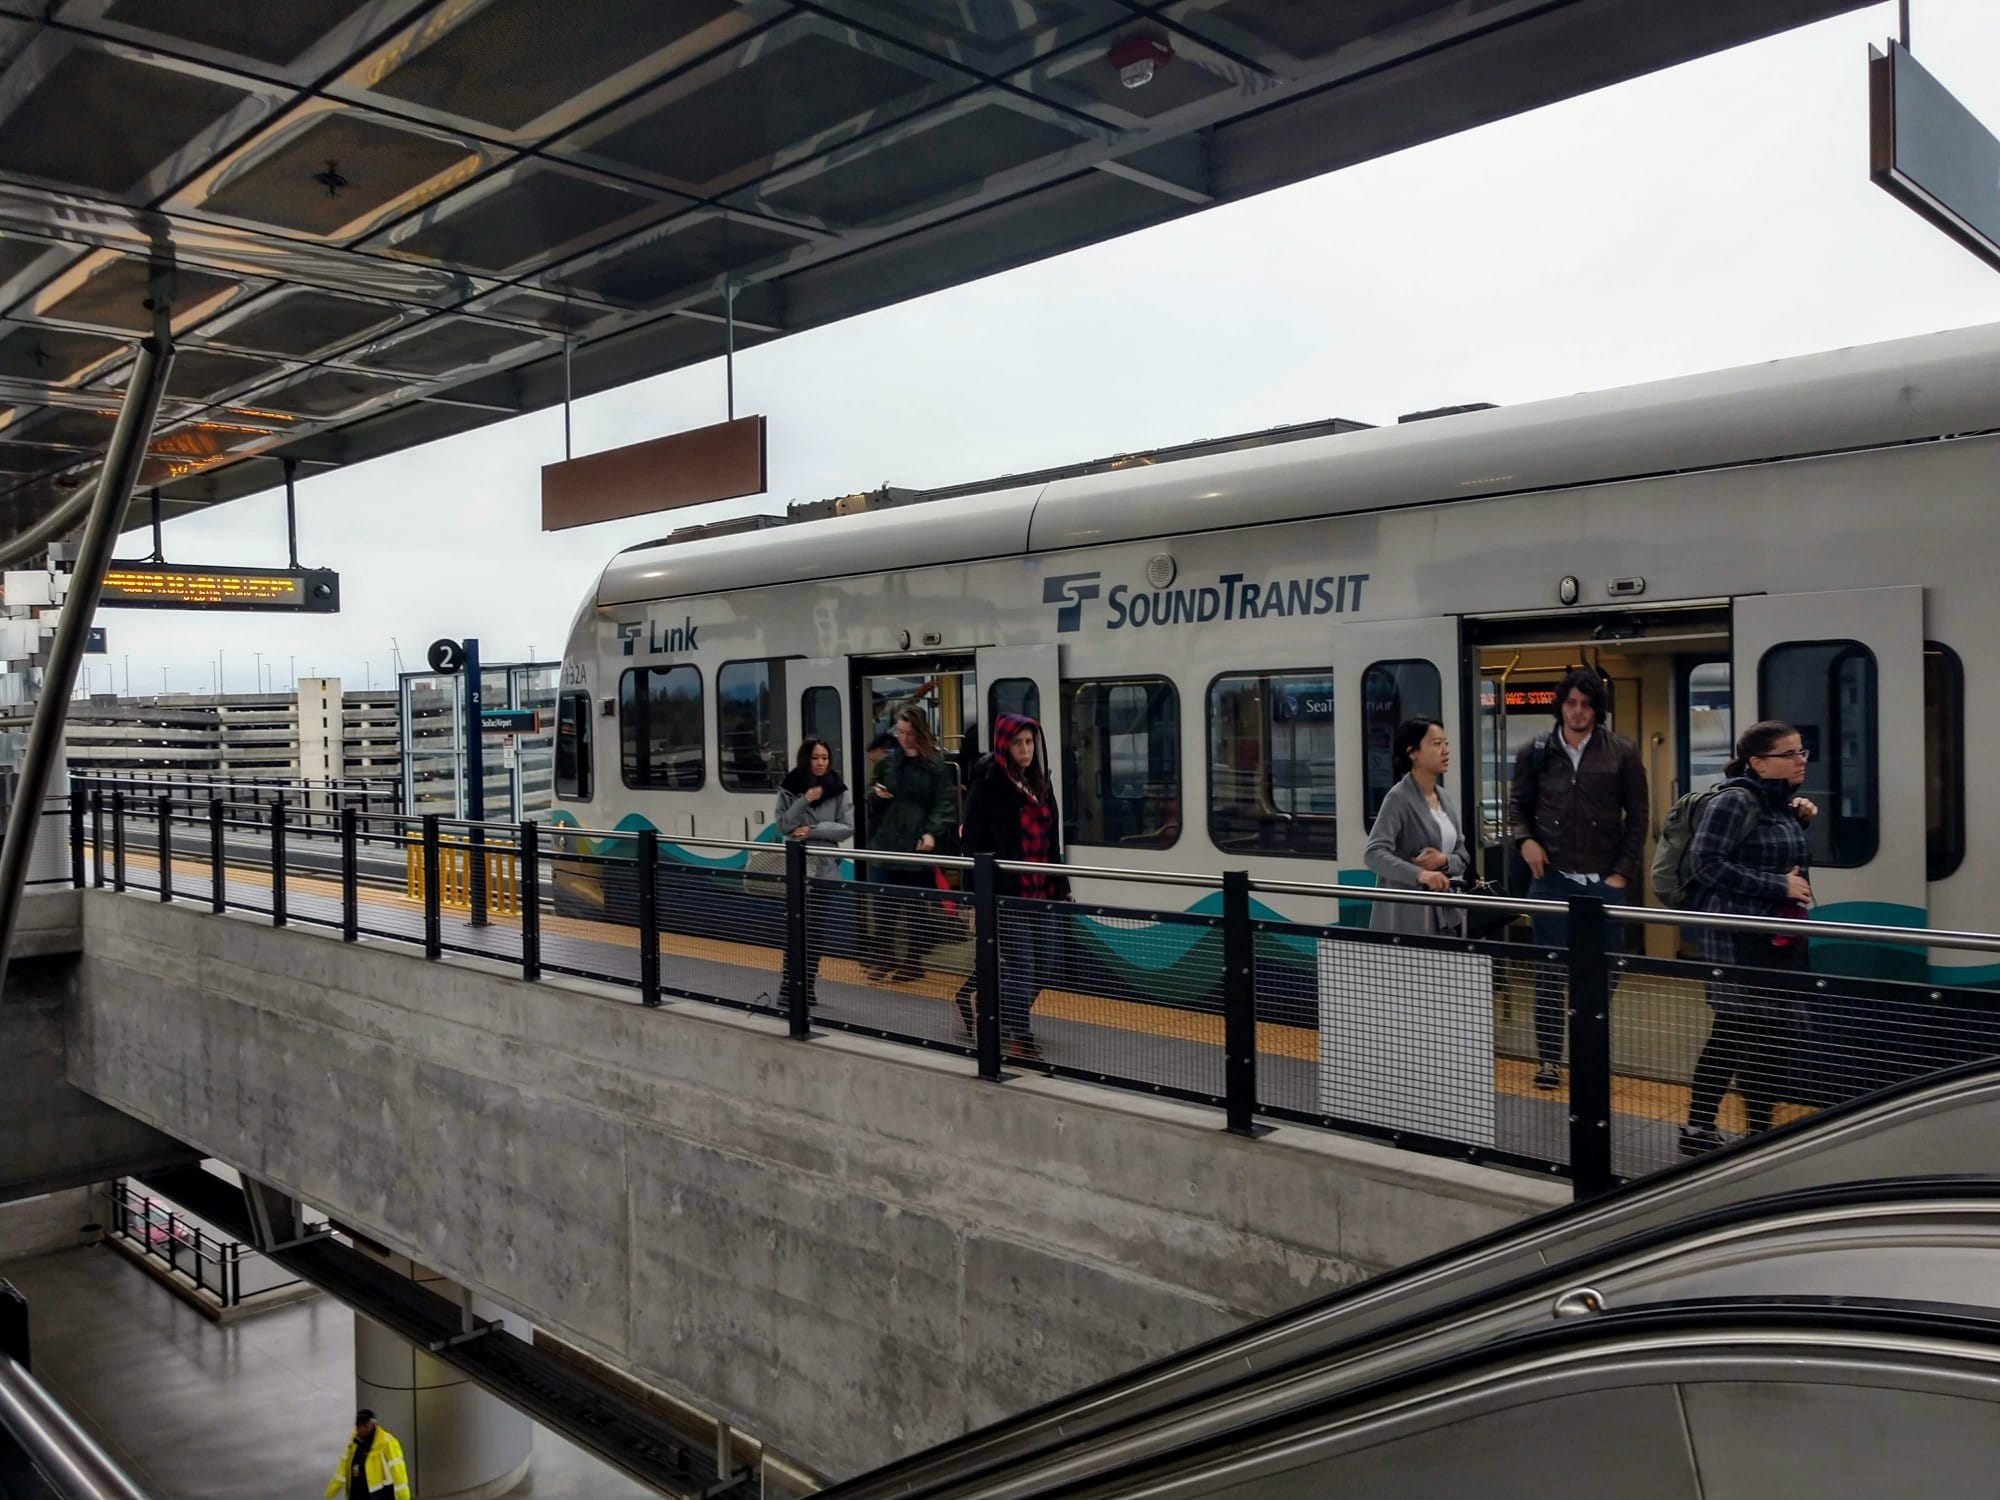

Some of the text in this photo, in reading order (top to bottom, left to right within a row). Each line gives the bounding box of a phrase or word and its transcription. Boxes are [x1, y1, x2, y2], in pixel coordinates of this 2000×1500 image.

[650, 615, 699, 654] Link
[439, 645, 454, 668] 2
[472, 692, 479, 703] 2
